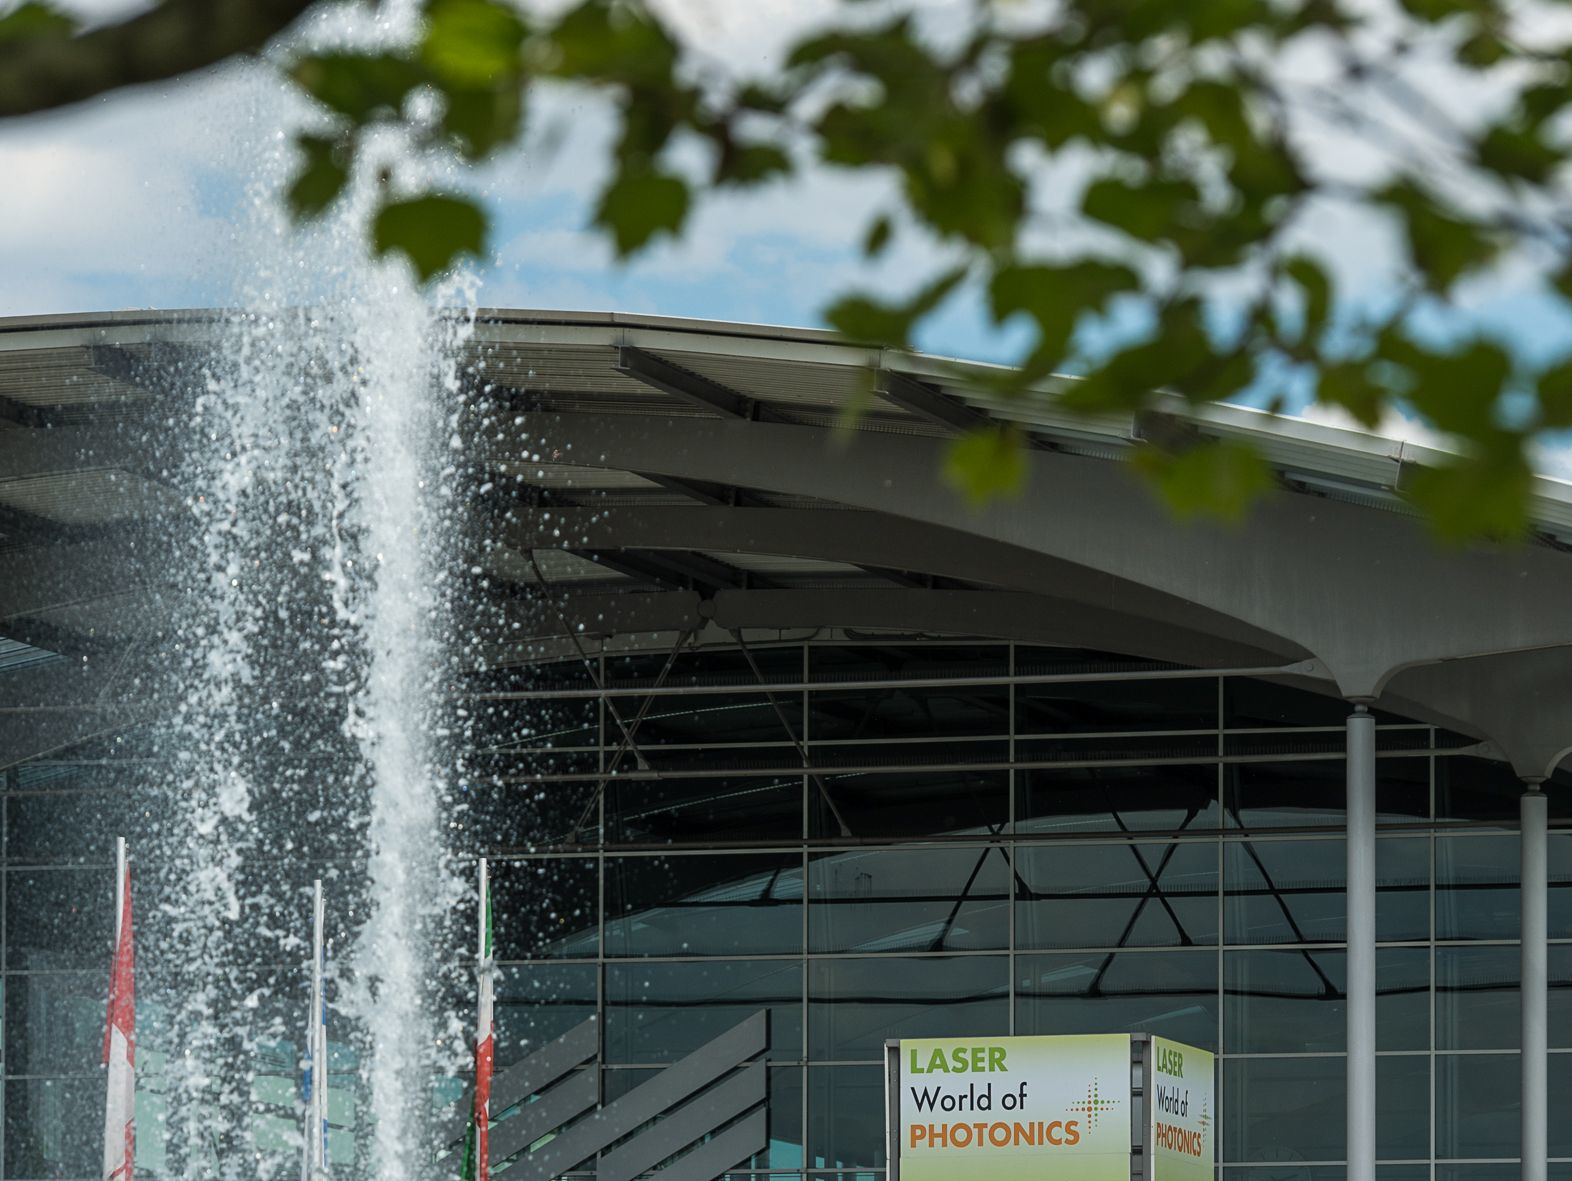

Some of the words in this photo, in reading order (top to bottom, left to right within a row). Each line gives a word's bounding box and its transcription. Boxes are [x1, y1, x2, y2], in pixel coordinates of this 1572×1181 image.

[910, 1047, 1009, 1074] LASER
[1156, 1046, 1184, 1078] LASER
[911, 1083, 992, 1112] World
[1001, 1082, 1028, 1111] of
[1156, 1084, 1179, 1116] World
[1181, 1090, 1189, 1118] of
[910, 1120, 1080, 1148] PHOTONICS
[1156, 1122, 1201, 1157] PHOTONICS
